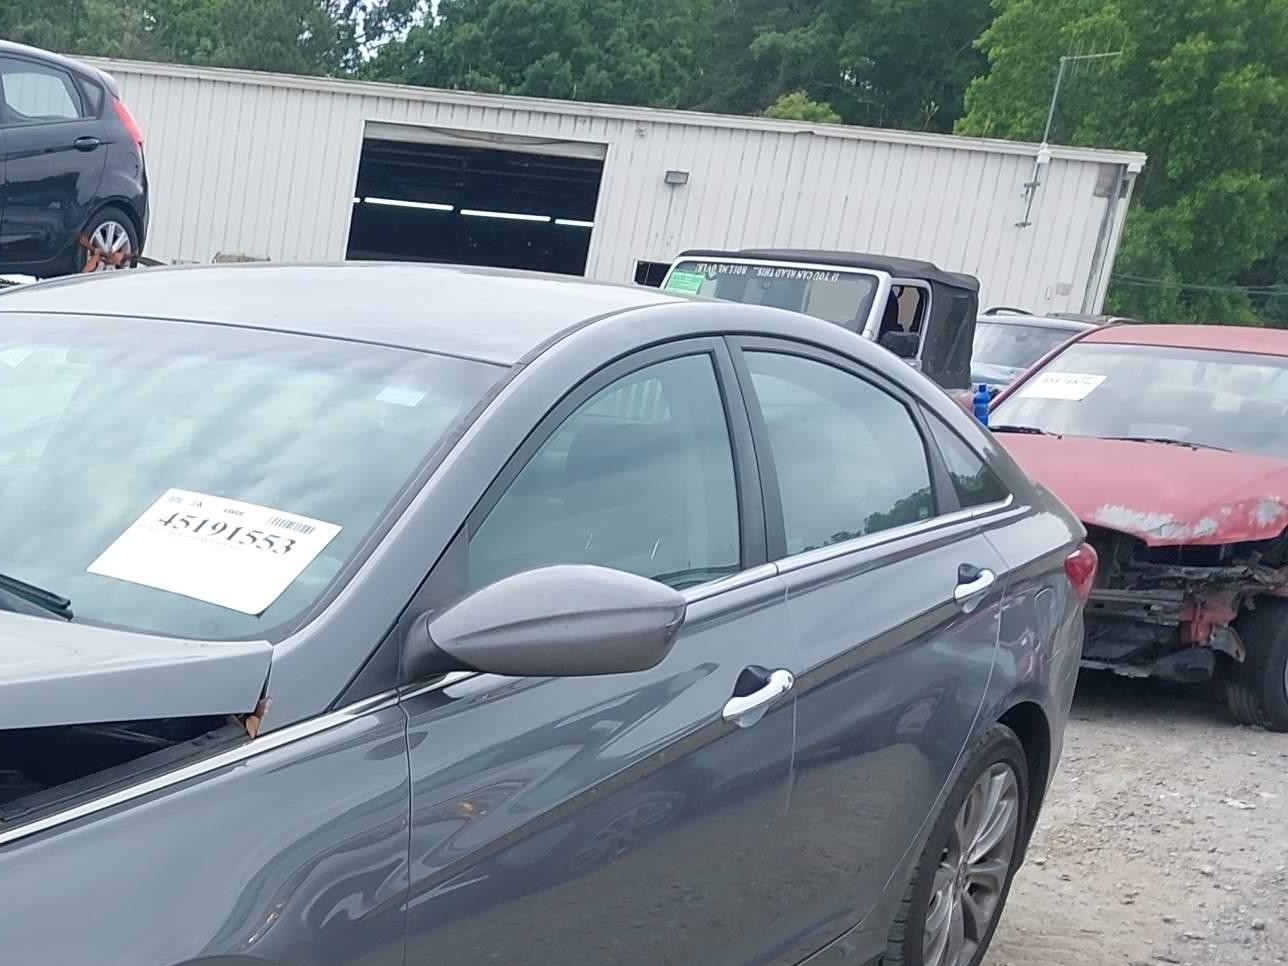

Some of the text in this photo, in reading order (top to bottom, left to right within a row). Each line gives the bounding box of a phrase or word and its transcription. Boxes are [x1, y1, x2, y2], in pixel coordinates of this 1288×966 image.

[719, 264, 729, 274] ME
[729, 265, 748, 275] ROLL
[775, 269, 796, 279] READ
[796, 270, 813, 280] CAN
[813, 271, 830, 281] YOU
[158, 511, 296, 555] 45191553
